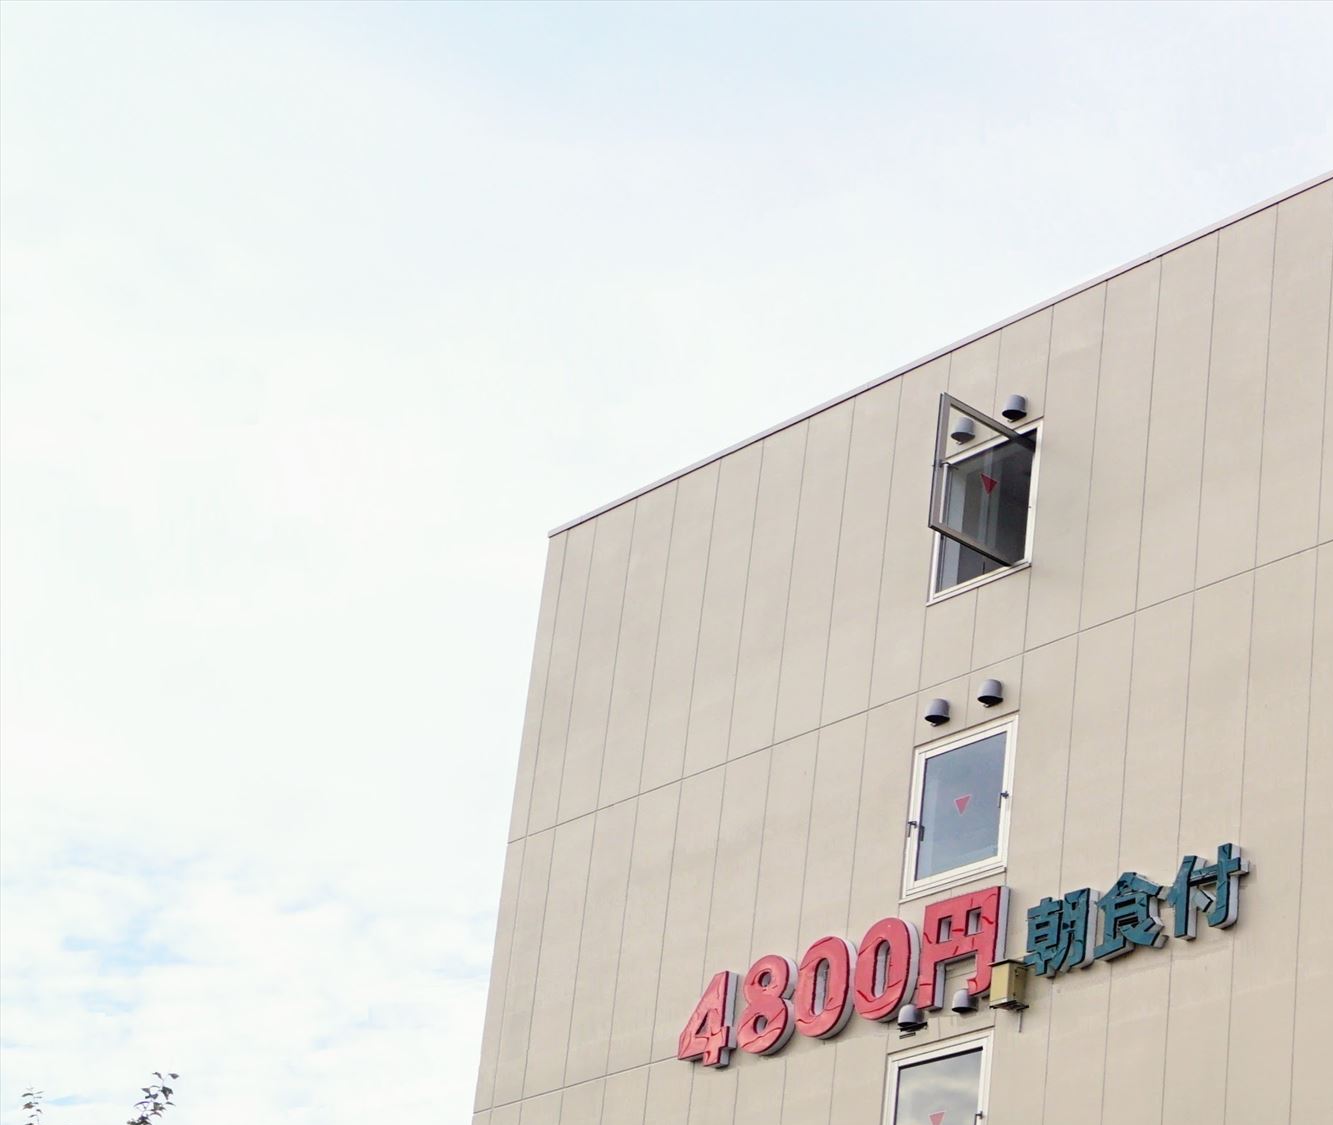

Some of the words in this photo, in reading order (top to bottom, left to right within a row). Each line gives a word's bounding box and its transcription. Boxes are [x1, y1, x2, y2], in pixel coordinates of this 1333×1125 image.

[678, 886, 1008, 1067] 4800円
[1026, 843, 1249, 977] 朝食付
